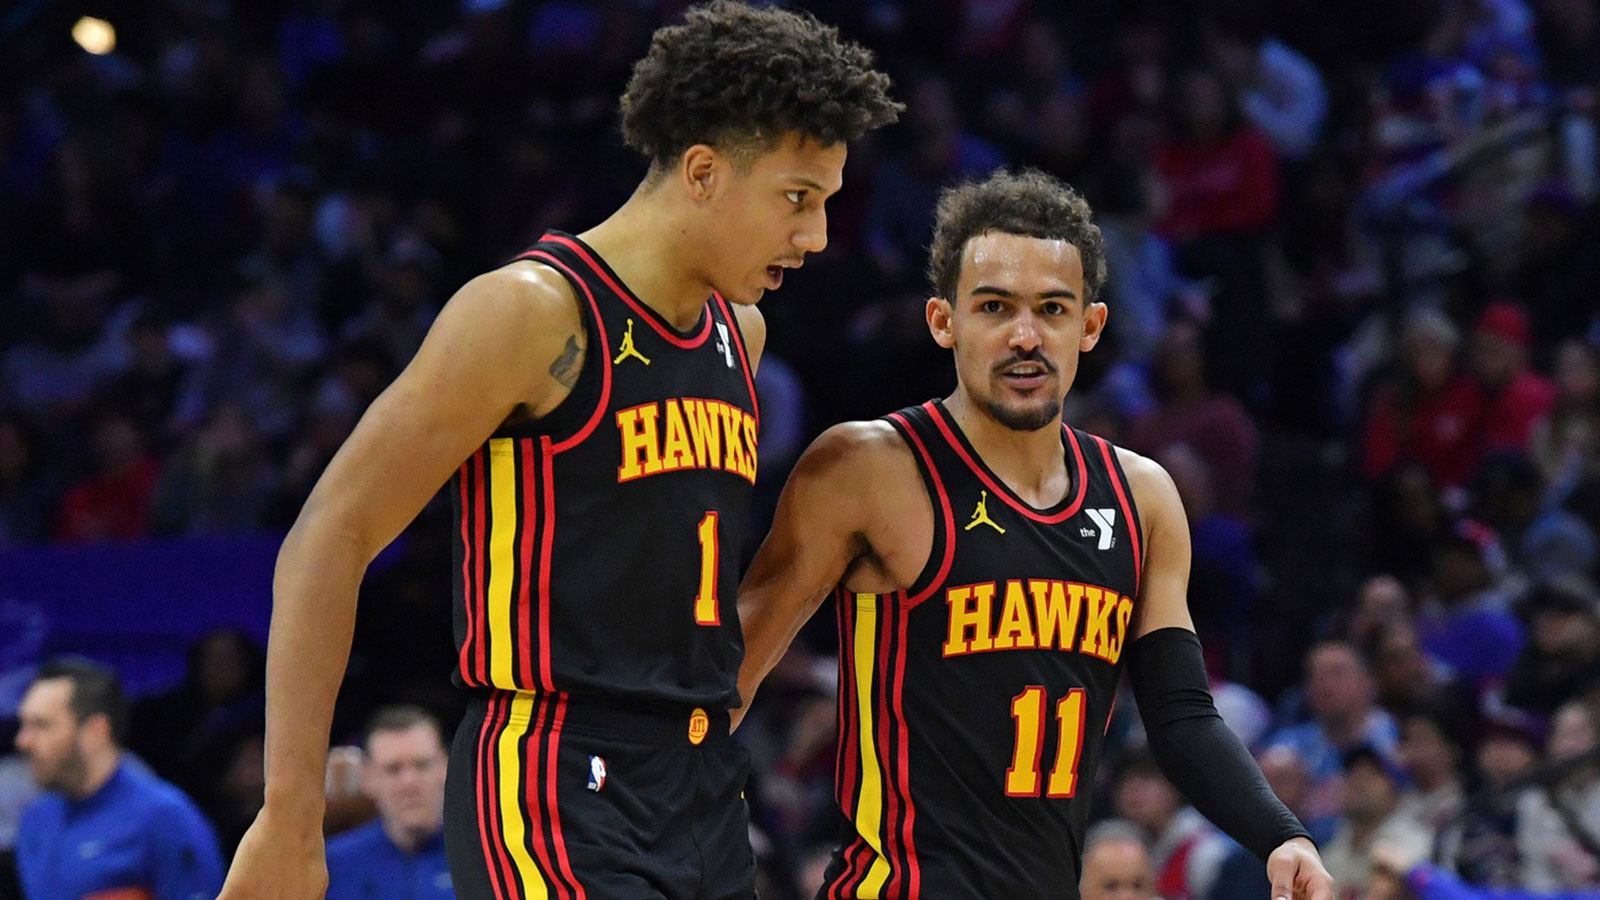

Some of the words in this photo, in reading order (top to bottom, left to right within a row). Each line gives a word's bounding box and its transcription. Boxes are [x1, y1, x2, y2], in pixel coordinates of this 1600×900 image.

[615, 397, 758, 486] HAWKS
[693, 510, 721, 626] 1
[1080, 527, 1096, 537] the
[942, 578, 1135, 665] HAWKS
[1004, 685, 1087, 798] 11
